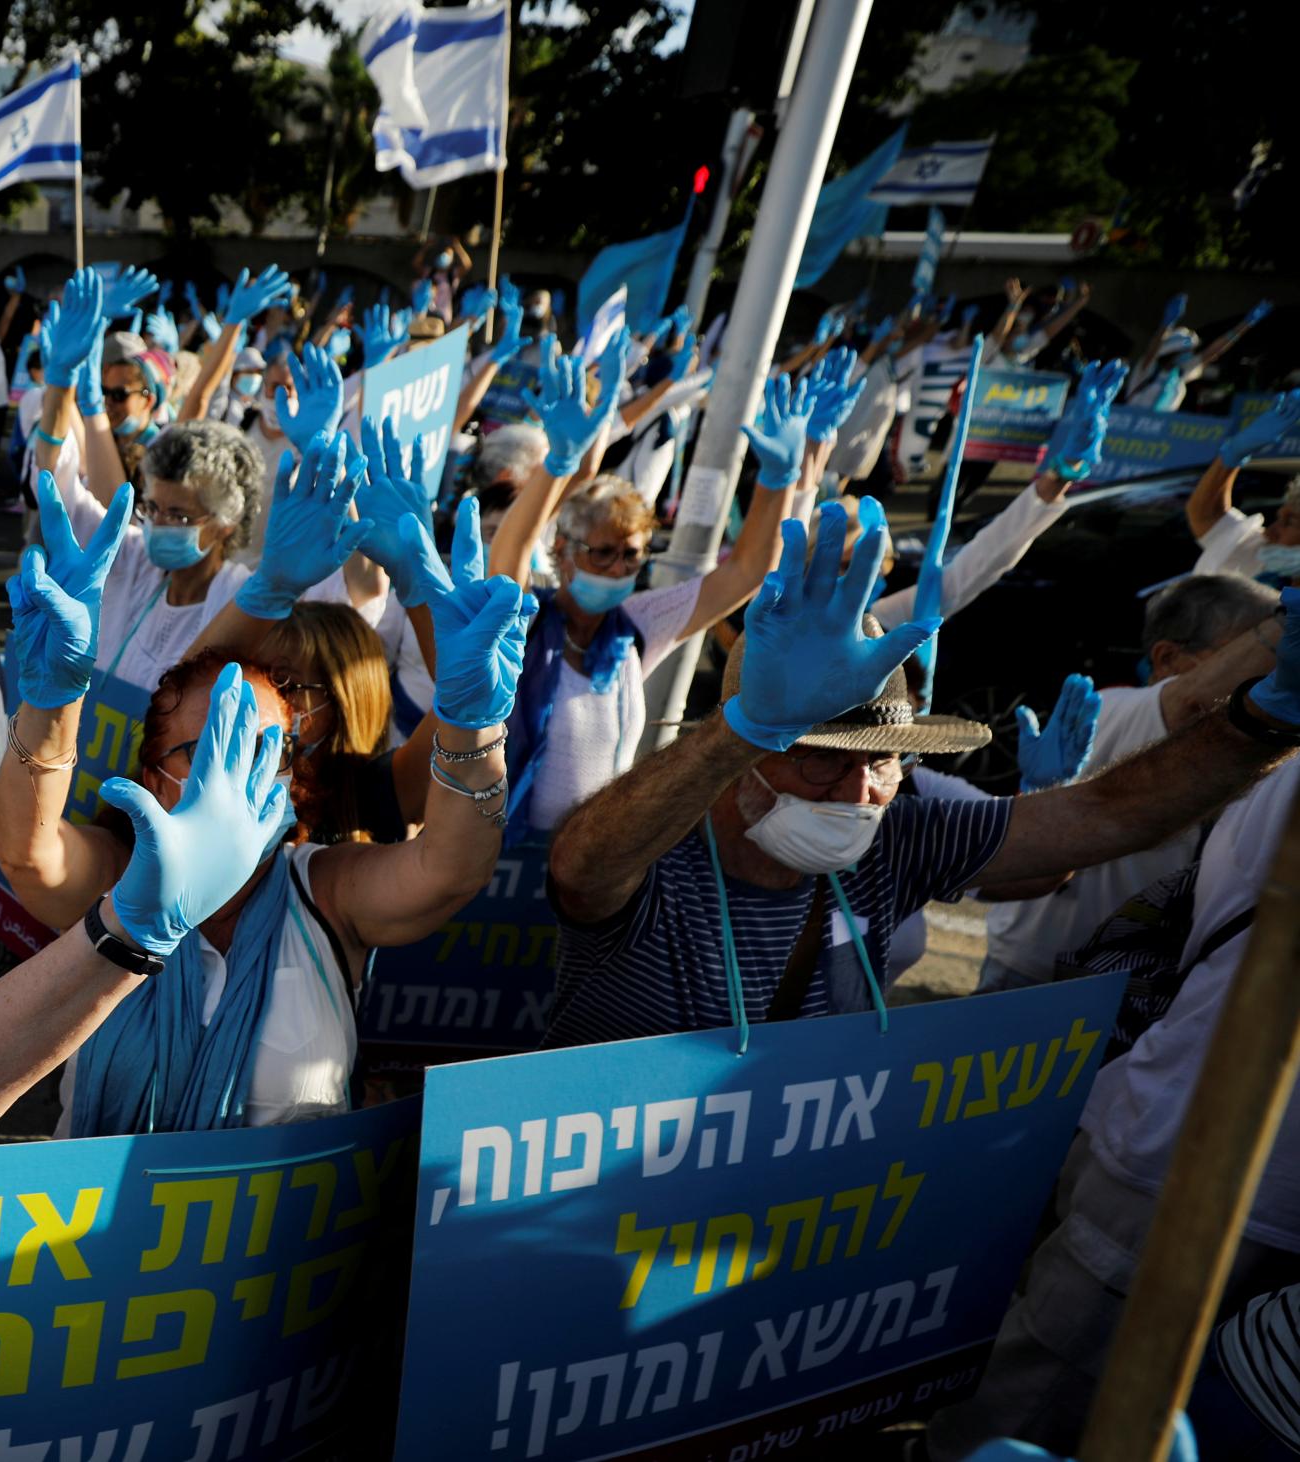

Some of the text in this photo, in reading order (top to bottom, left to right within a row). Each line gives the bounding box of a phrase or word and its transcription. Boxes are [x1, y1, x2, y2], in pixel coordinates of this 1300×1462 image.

[430, 1018, 1101, 1226] לעצור את הסיפוח,
[140, 1134, 416, 1273] צרות
[615, 1161, 926, 1310] להתחיל
[181, 1352, 358, 1462] שות
[490, 1265, 960, 1460] במשא ומתן!
[813, 1391, 903, 1438] עושות
[726, 1424, 806, 1462] שלום
